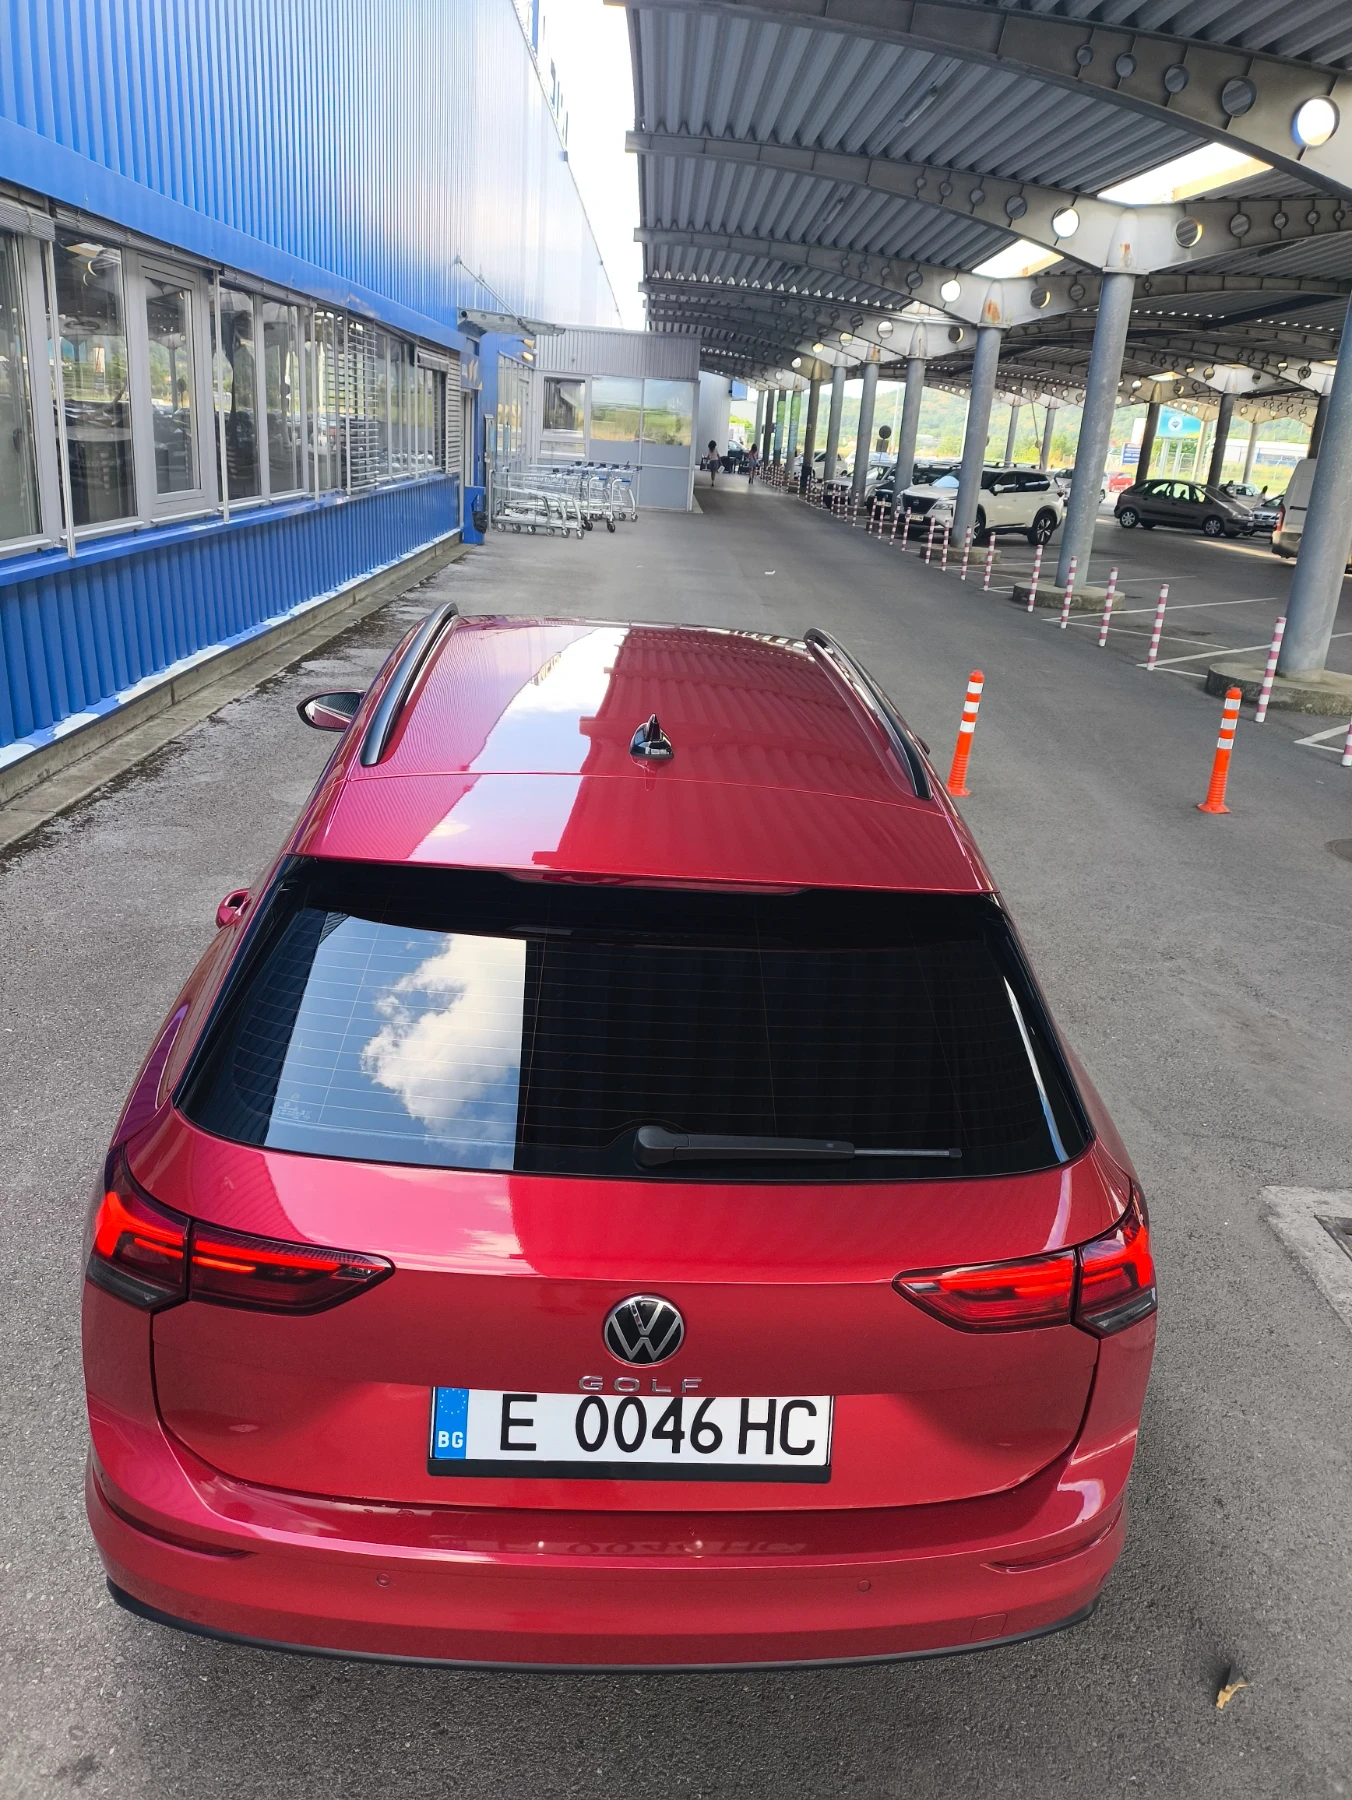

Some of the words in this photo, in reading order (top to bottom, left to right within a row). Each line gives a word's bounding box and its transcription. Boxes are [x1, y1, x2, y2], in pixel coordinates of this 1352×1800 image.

[578, 1375, 702, 1393] GOLF
[500, 1393, 538, 1451] E
[575, 1395, 723, 1454] 0046
[737, 1397, 817, 1456] HC
[437, 1430, 464, 1449] BG
